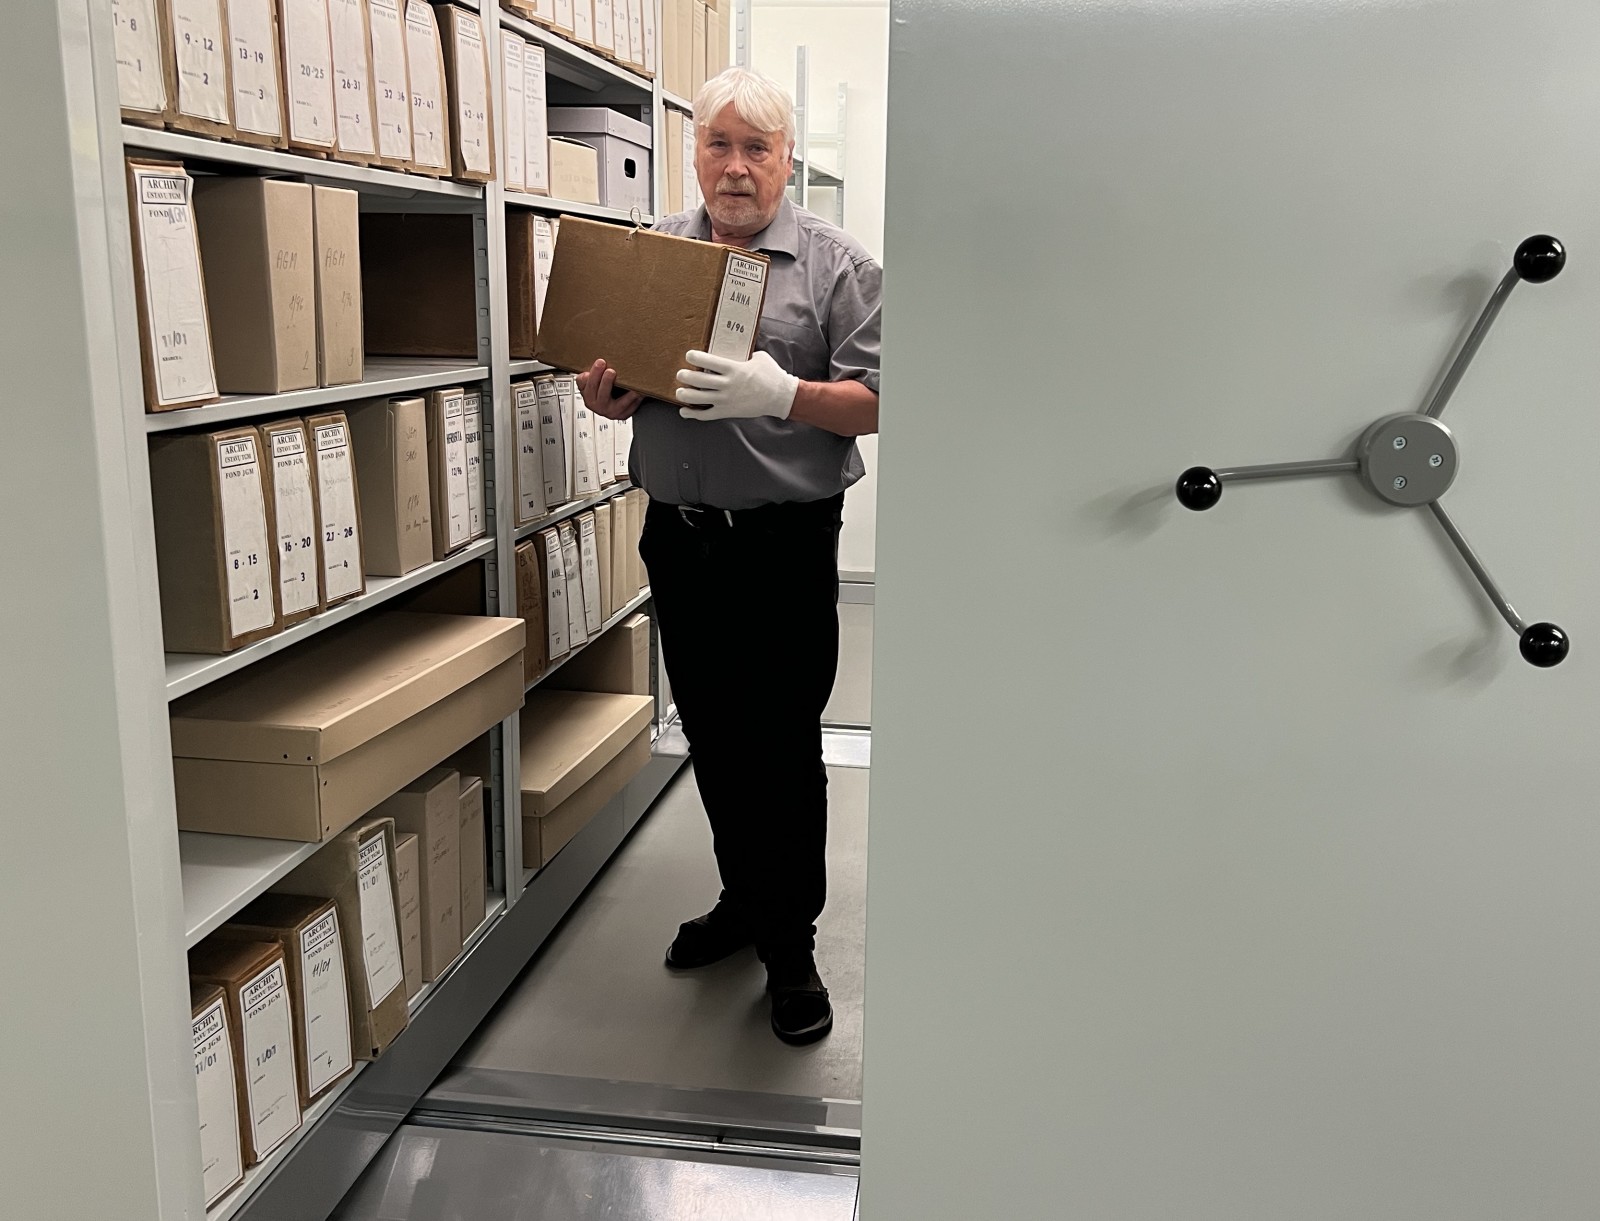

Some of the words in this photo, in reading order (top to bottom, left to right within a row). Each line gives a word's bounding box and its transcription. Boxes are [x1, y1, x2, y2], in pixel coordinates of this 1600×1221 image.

[130, 18, 137, 31] 8
[185, 33, 190, 44] 9
[203, 37, 213, 51] 12
[137, 59, 141, 72] 1
[203, 73, 208, 85] 2
[259, 89, 264, 99] 3
[384, 89, 392, 99] 32
[355, 114, 360, 123] 5
[397, 124, 401, 133] 6
[476, 139, 480, 147] 8
[148, 179, 178, 189] ARCHIV
[149, 209, 169, 218] FOND
[735, 260, 758, 273] ARCHIV
[731, 278, 746, 287] FOND
[730, 290, 750, 306] ANNA
[726, 320, 745, 334] 8/96
[522, 420, 533, 430] ANNA
[542, 415, 553, 425] ANNA
[321, 428, 340, 439] ARCHIV
[277, 434, 297, 445] ARCHIV
[225, 443, 248, 455] ARCHIV
[523, 444, 534, 454] 8/96
[321, 453, 334, 461] FOND
[335, 450, 345, 459] JGM
[277, 459, 292, 468] FOND
[293, 457, 303, 466] JGM
[225, 470, 241, 479] FOND
[242, 468, 254, 477] JGM
[326, 532, 334, 542] 21
[284, 541, 292, 552] 16
[301, 536, 311, 549] 20
[234, 558, 239, 570] 8
[248, 553, 258, 566] 15
[343, 560, 348, 568] 4
[300, 572, 305, 582] 3
[253, 589, 259, 600] 2
[359, 844, 378, 860] RCHIV
[359, 869, 371, 880] OND
[308, 919, 329, 939] ARCHIV
[307, 946, 322, 960] FOND
[323, 938, 335, 950] JGM
[248, 972, 275, 997] ARCHIV
[249, 1003, 266, 1019] FOND
[268, 993, 281, 1006] JGM
[192, 1013, 215, 1036] RCHIV
[207, 1035, 222, 1050] JGM
[195, 1052, 217, 1075] 11/01
